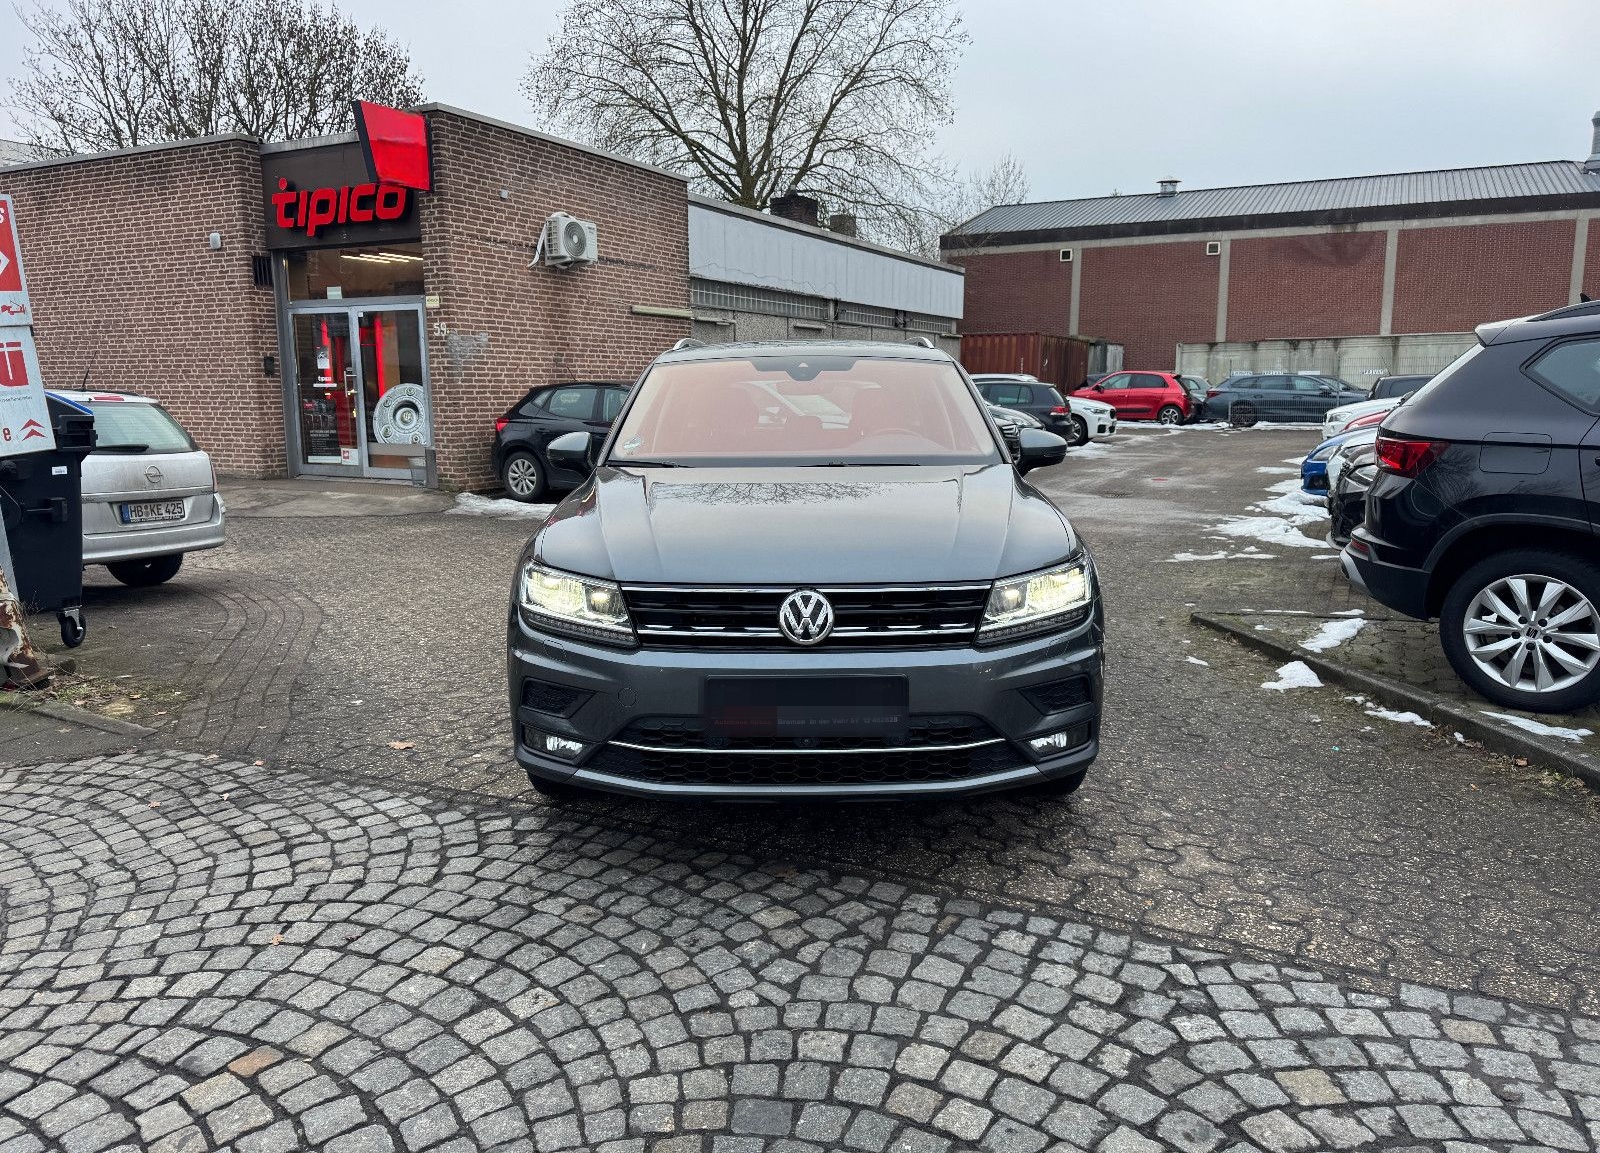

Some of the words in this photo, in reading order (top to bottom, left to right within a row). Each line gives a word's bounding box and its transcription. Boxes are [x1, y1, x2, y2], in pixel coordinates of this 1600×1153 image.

[271, 177, 407, 237] tipico
[433, 322, 447, 337] 59
[129, 505, 144, 518] HB
[149, 504, 164, 516] KE
[165, 502, 183, 515] 425
[779, 590, 834, 645] VW
